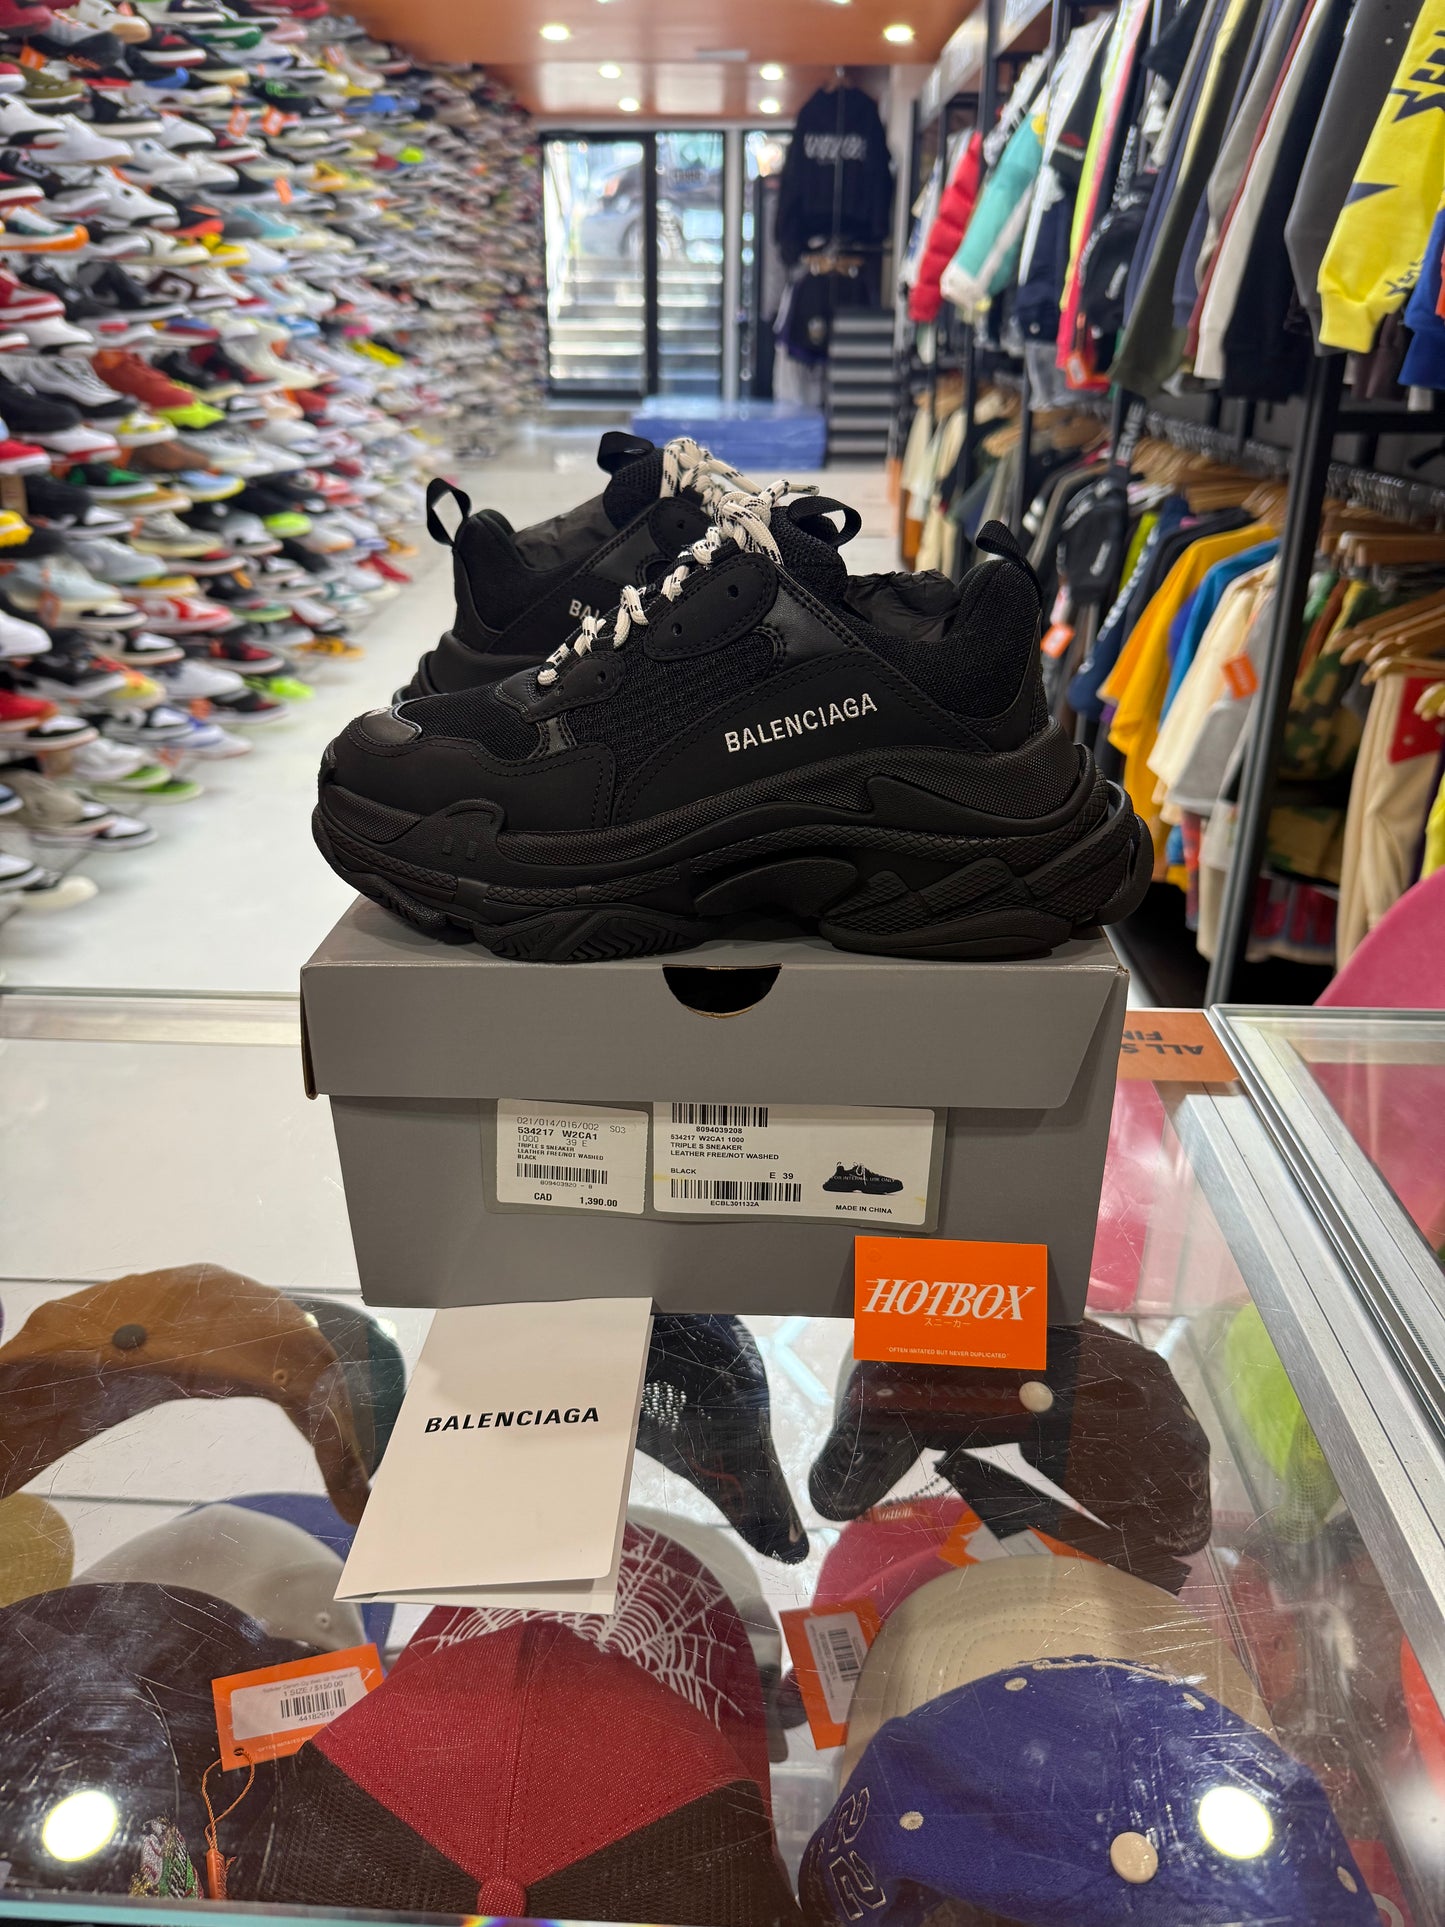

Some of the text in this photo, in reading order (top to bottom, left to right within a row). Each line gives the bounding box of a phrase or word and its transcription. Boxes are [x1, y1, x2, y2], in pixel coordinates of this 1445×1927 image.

[725, 692, 877, 753] BALENCIAGA
[1145, 1043, 1204, 1055] ALL
[517, 1116, 626, 1134] 021/014/016/002 S03
[696, 1126, 743, 1134] 8094039208
[517, 1127, 598, 1140] 534217 W2CA1
[518, 1135, 539, 1143] 1000
[578, 1153, 604, 1161] WASHED
[706, 1151, 744, 1159] FREE/NOT
[782, 1172, 794, 1180] 39
[534, 1192, 618, 1207] CAD 1,390.00
[868, 1206, 893, 1214] CHINA
[862, 1278, 1036, 1321] HOTBOX
[924, 1317, 972, 1328] スニーカー
[424, 1407, 600, 1434] BALENCIAGA
[290, 1687, 309, 1696] SIZE
